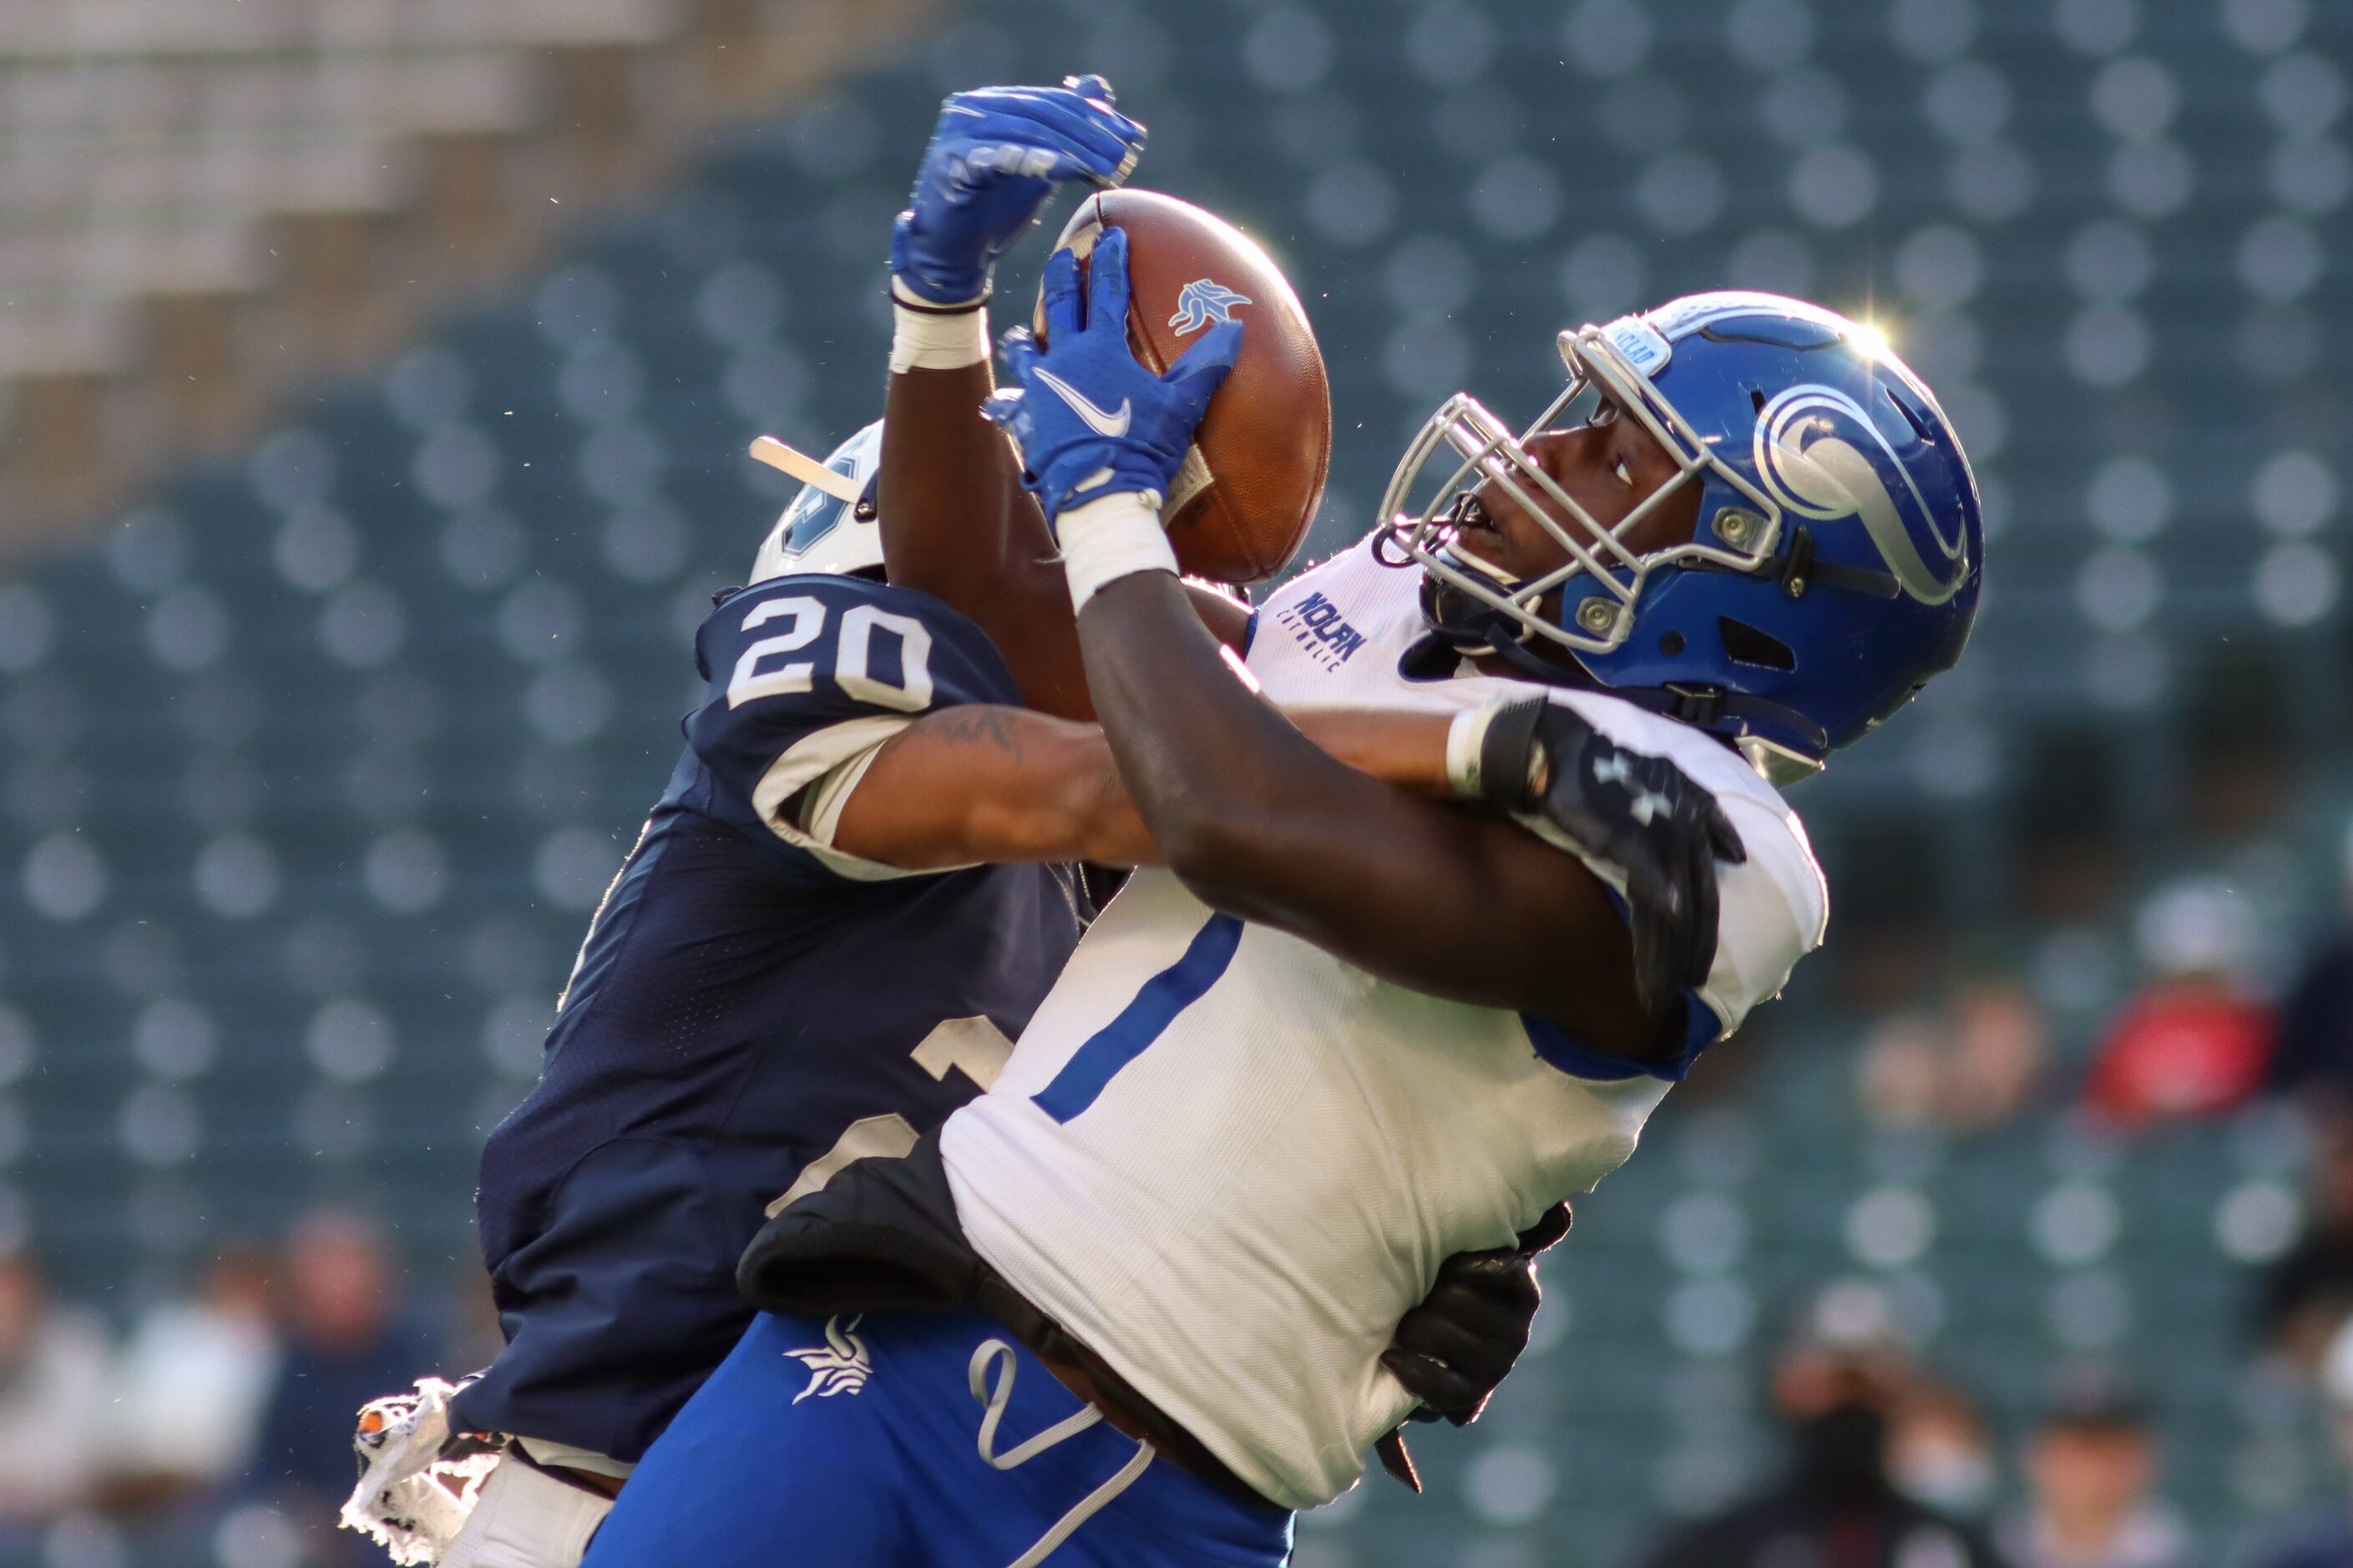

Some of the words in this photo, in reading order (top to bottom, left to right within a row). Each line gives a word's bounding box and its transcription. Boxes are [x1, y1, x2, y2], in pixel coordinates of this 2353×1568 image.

[727, 595, 933, 713] 20
[1277, 609, 1340, 673] CATHOLIC
[1293, 591, 1367, 662] NOLAN
